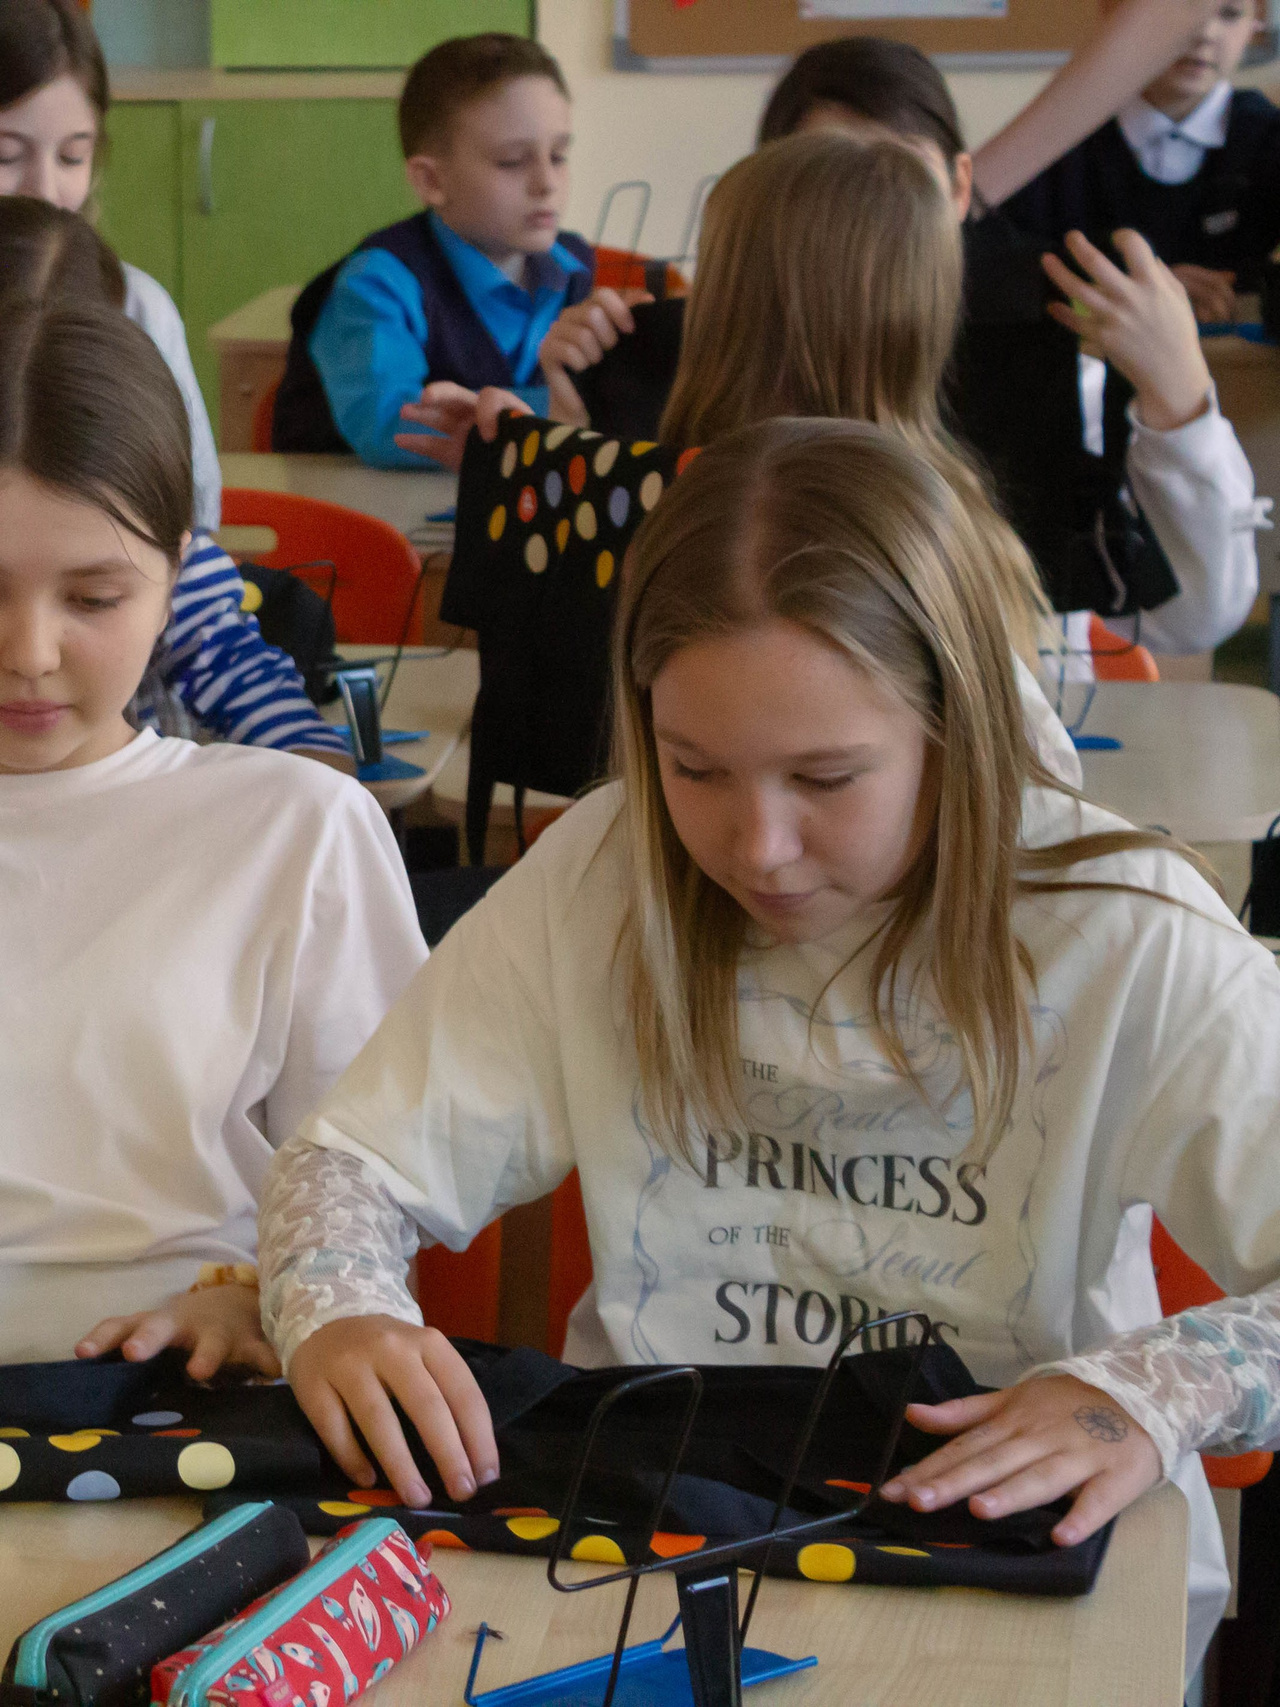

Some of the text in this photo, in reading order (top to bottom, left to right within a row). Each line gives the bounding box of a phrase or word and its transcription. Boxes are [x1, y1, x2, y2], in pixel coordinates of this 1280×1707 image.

[741, 1059, 779, 1083] THE
[747, 1085, 914, 1142] Real
[703, 1131, 988, 1226] PRINCESS
[709, 1227, 742, 1245] OF
[753, 1225, 792, 1248] THE
